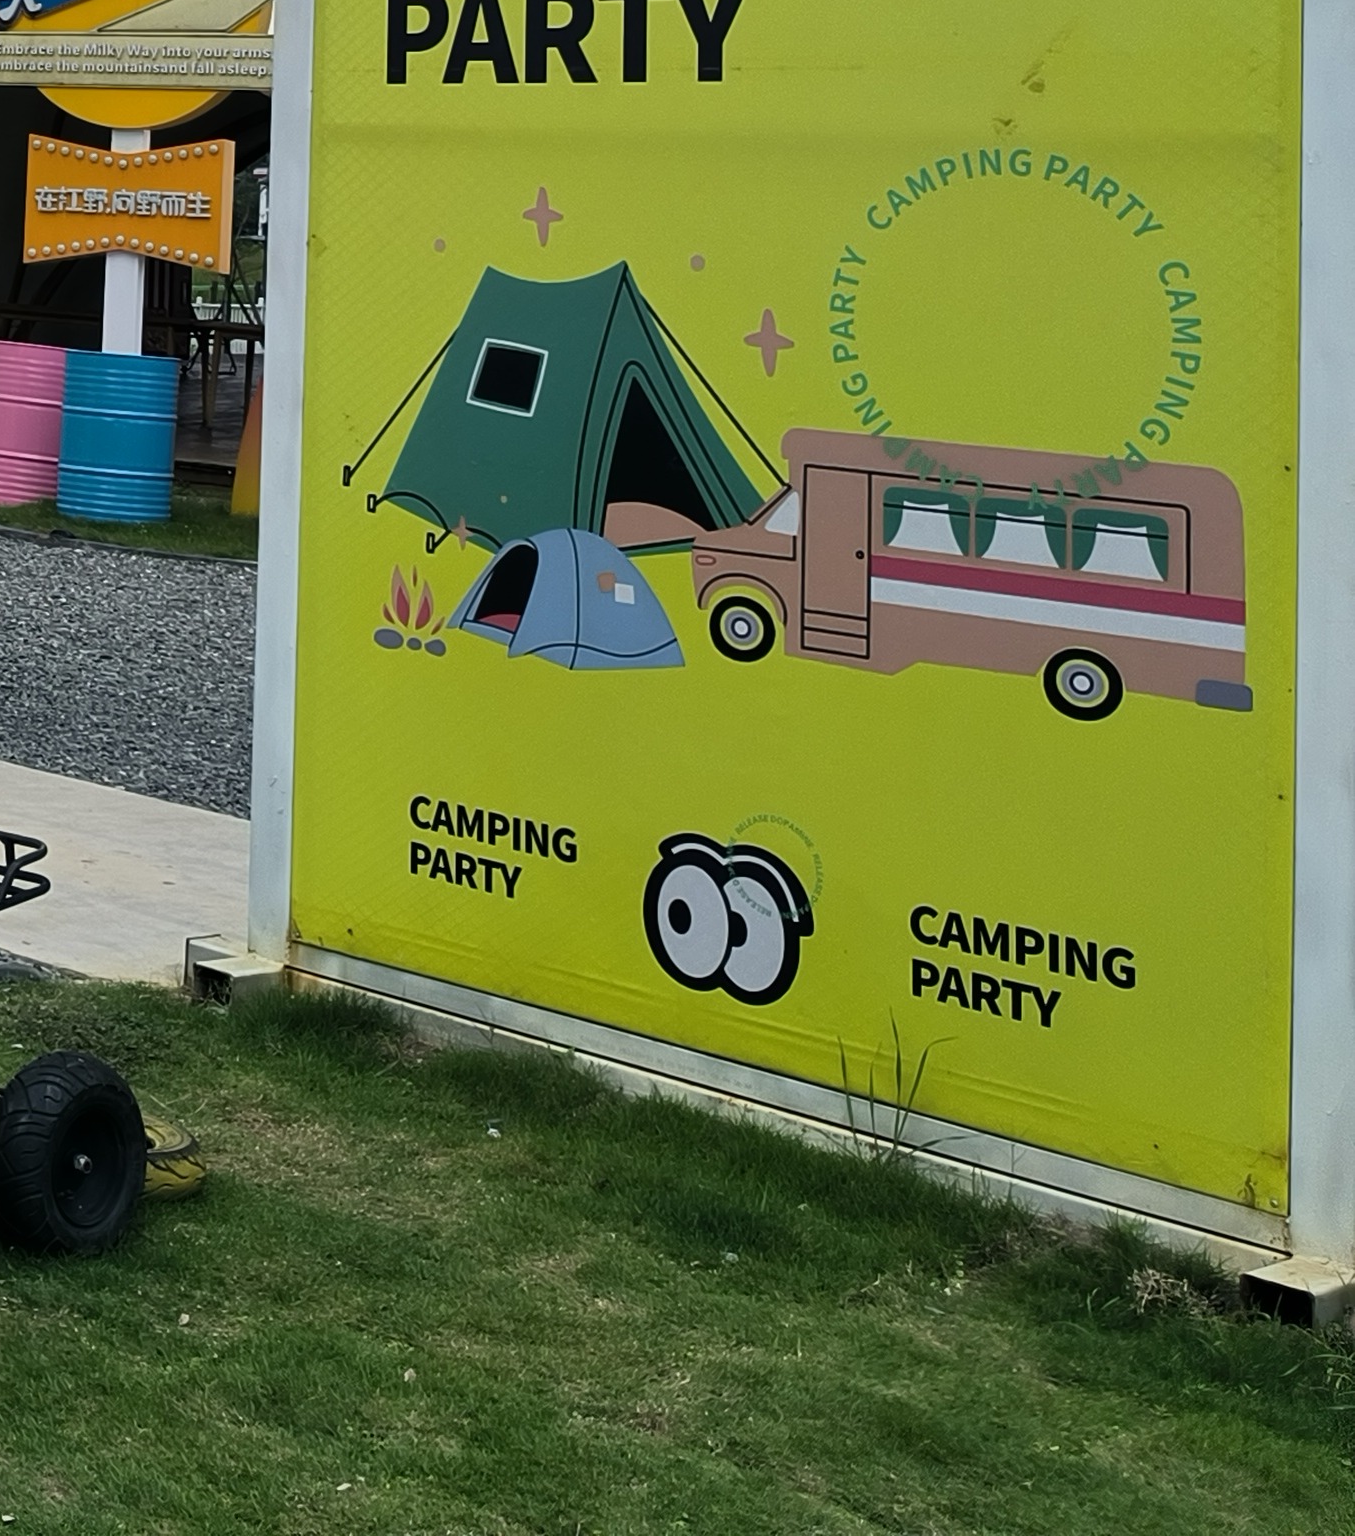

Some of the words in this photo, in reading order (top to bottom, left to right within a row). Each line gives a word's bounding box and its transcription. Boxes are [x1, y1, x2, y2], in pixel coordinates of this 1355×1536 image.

[56, 60, 79, 72] the
[190, 62, 215, 75] fall
[57, 44, 80, 56] the
[83, 44, 125, 60] Milky
[126, 45, 158, 61] Way
[162, 45, 191, 58] into
[194, 46, 230, 61] your
[866, 148, 1033, 230] CAMPING
[1043, 153, 1165, 238] PARTY
[828, 244, 867, 364] PARTY
[1140, 260, 1203, 446] CAMPING
[841, 371, 985, 504] CAMPING
[1027, 440, 1150, 510] PARTY
[408, 794, 579, 864] CAMPING
[407, 841, 523, 900] PARTY
[909, 904, 1137, 991] CAMPING
[910, 958, 1062, 1029] PARTY
